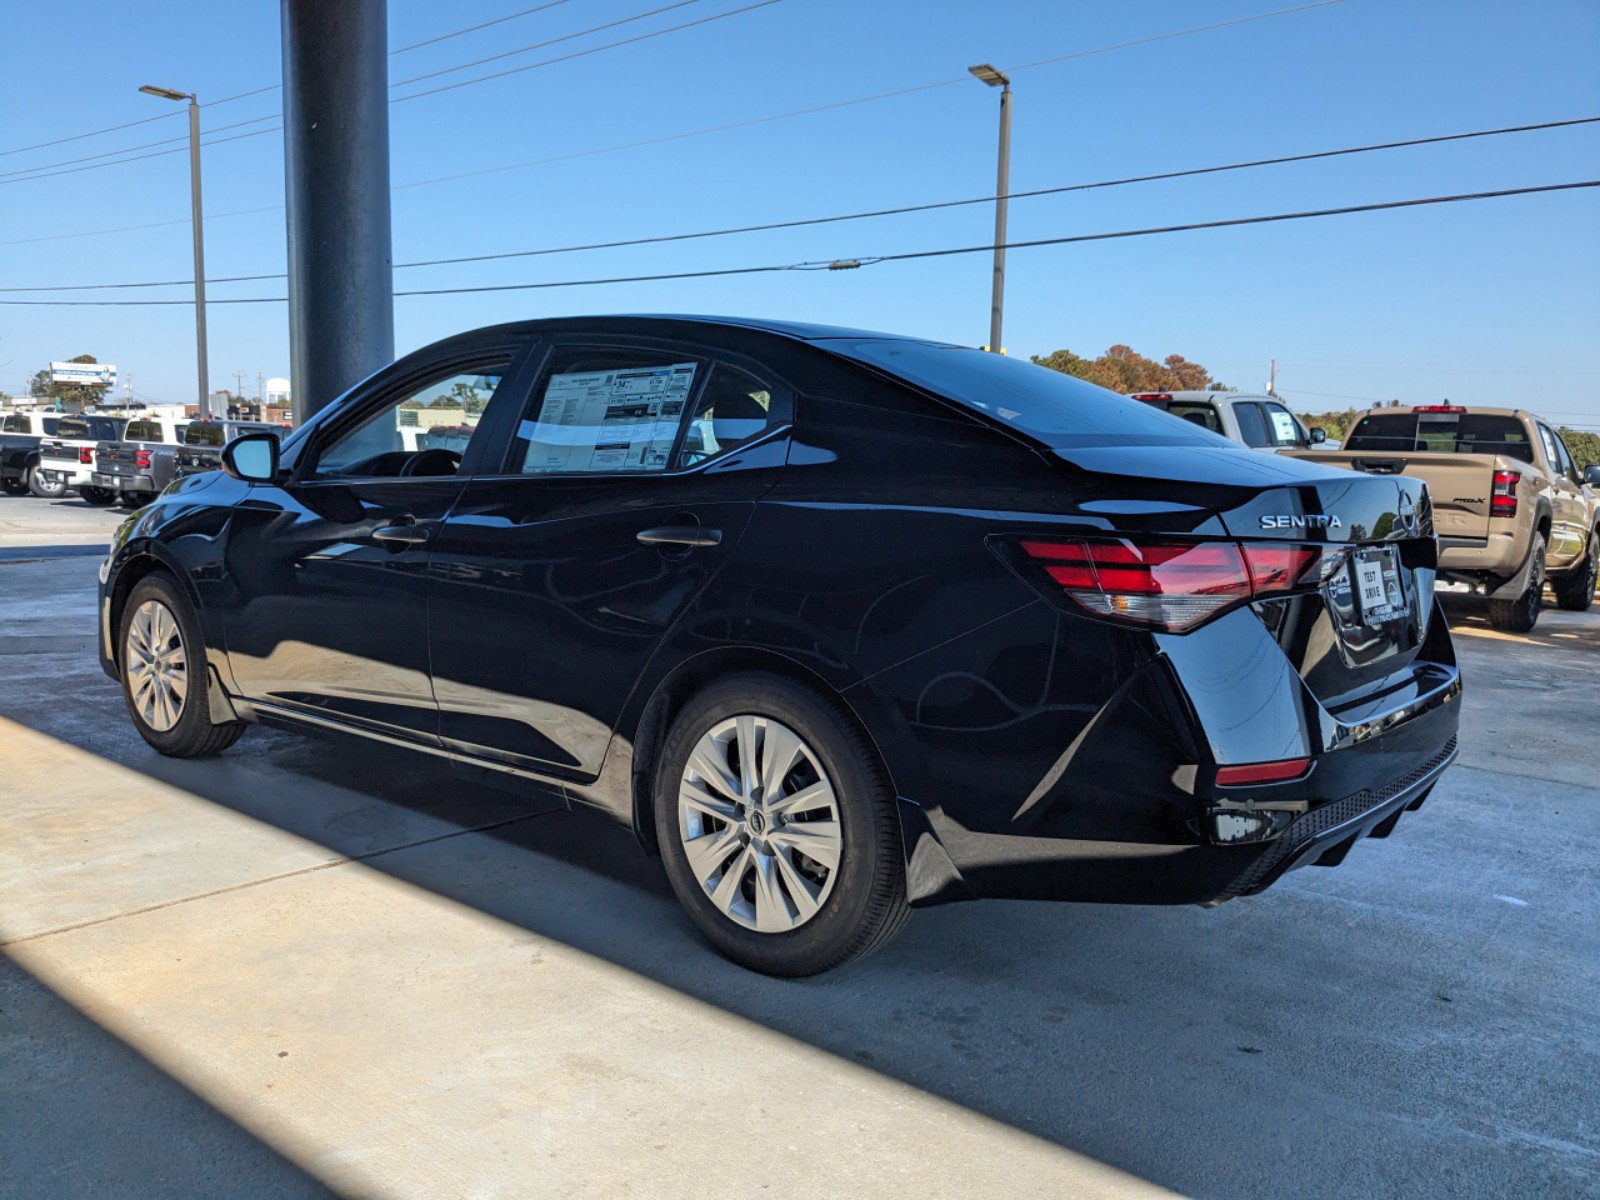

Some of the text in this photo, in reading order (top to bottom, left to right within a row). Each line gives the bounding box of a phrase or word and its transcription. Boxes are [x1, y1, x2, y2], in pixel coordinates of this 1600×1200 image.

[1260, 514, 1342, 529] SENTRA
[1364, 571, 1376, 583] TEST
[1365, 586, 1381, 600] DRIVE
